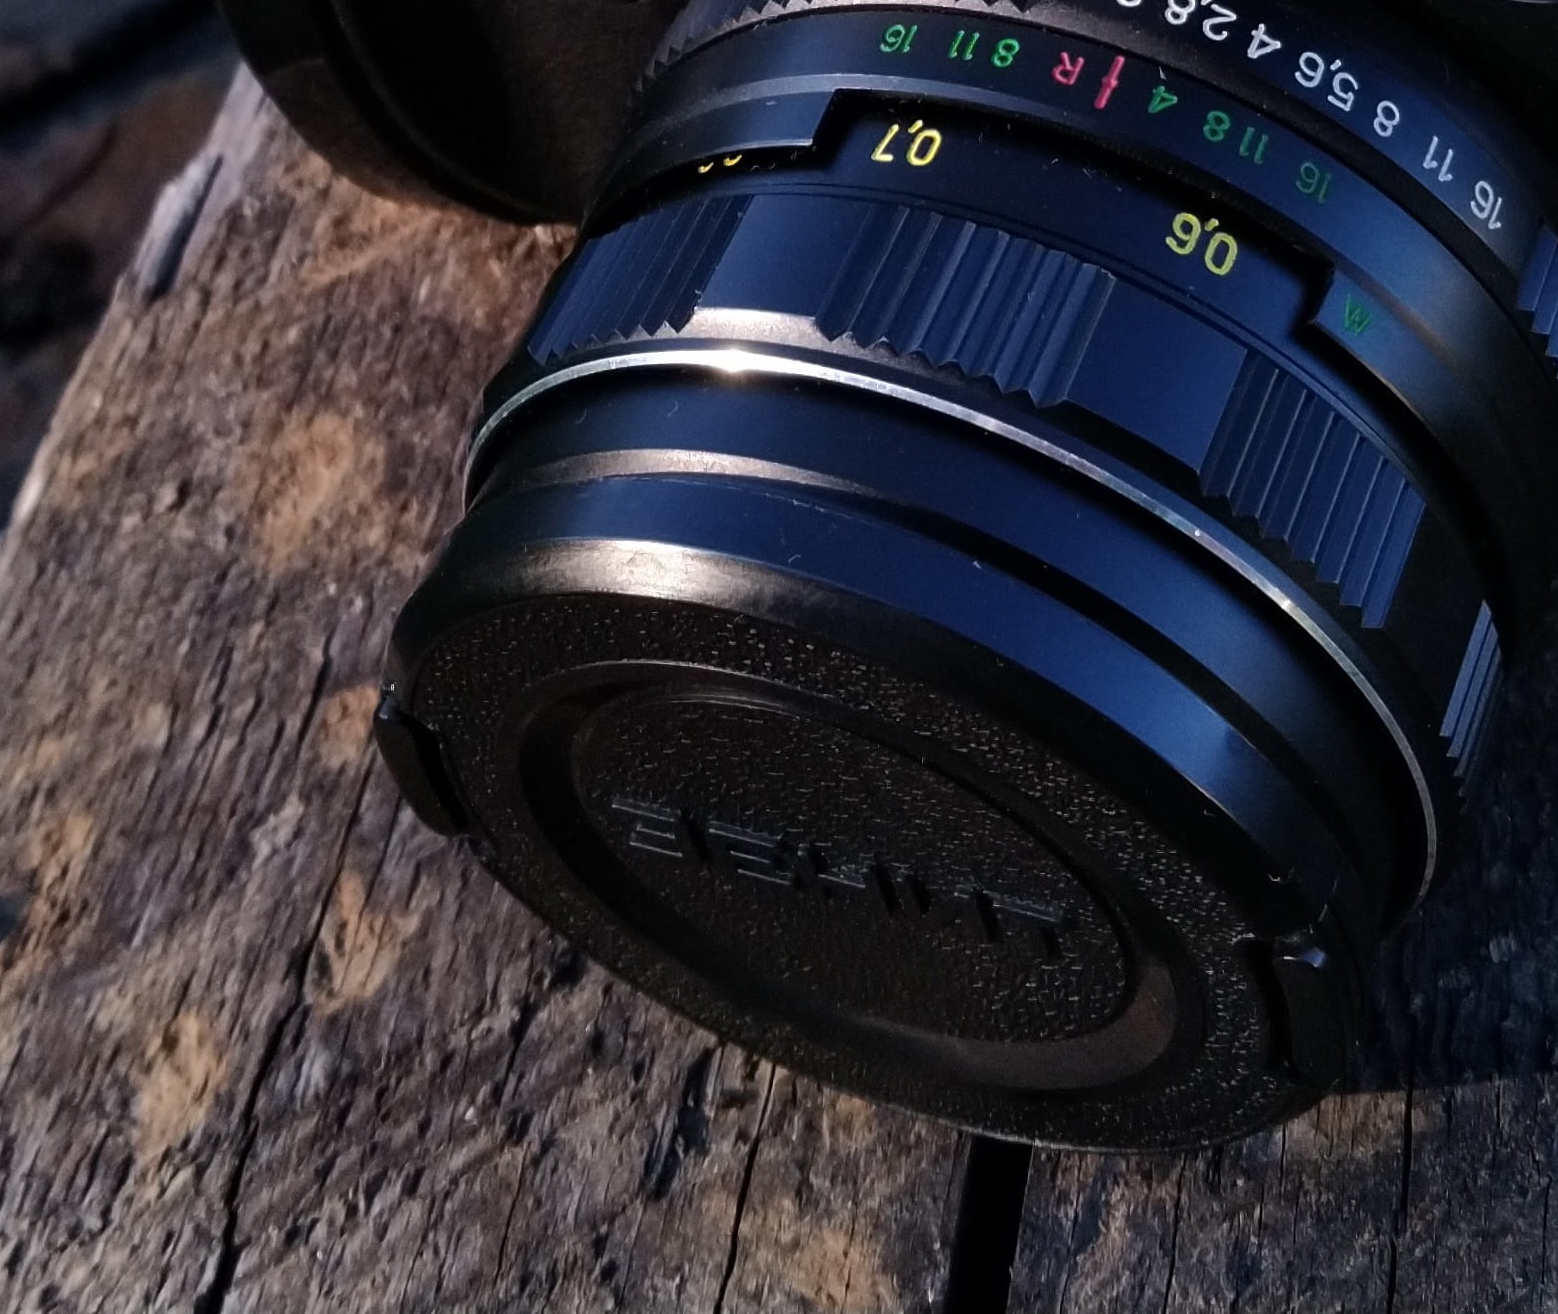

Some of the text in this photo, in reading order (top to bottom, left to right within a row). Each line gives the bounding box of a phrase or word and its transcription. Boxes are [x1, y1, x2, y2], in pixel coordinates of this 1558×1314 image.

[1246, 22, 1283, 61] 4
[878, 23, 1334, 205] 16 11 8 4 R 8 11 16
[1372, 99, 1402, 140] 8
[1420, 133, 1456, 185] 11
[868, 118, 1240, 278] 0,6 0,7
[1468, 178, 1505, 232] 16
